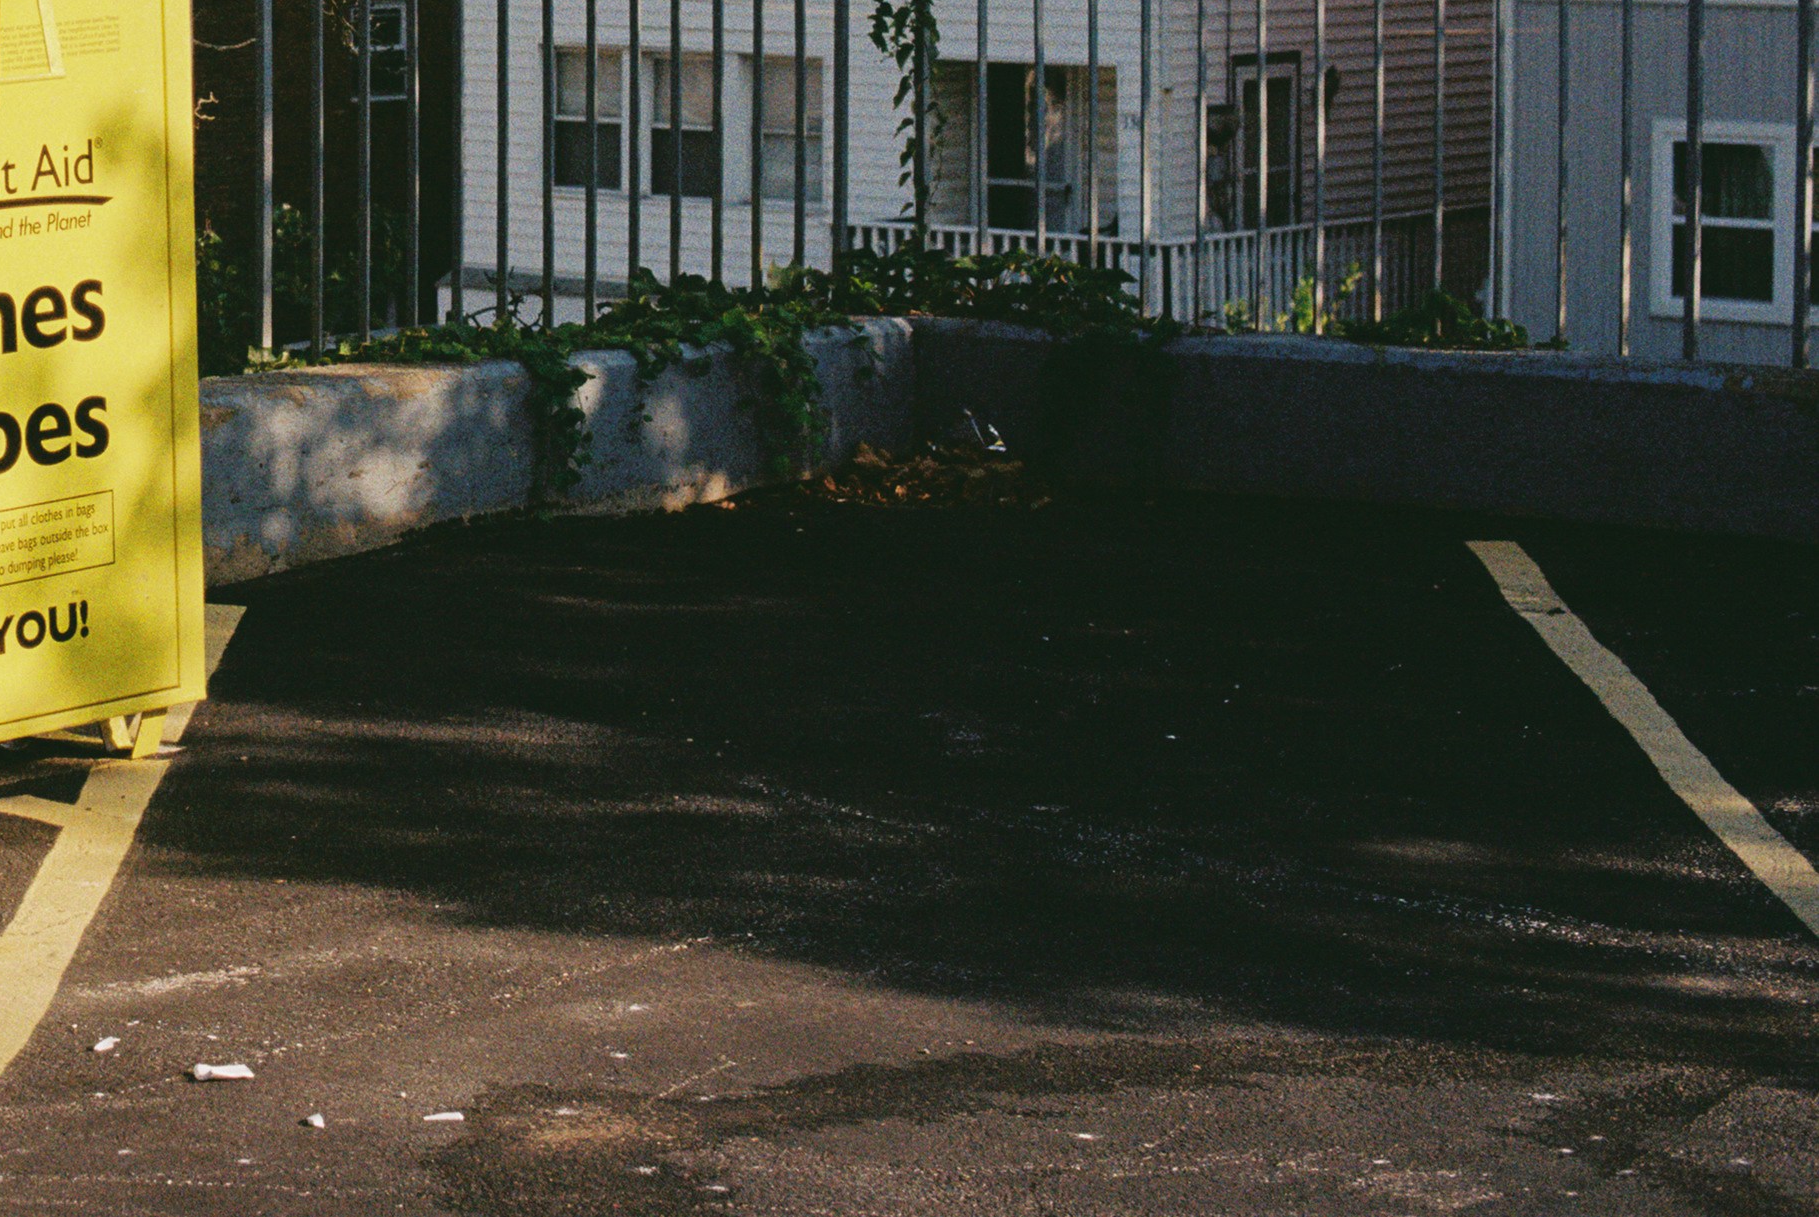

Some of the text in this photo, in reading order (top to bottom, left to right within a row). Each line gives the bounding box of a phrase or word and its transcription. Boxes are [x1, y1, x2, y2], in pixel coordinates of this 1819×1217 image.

[19, 216, 41, 235] the
[47, 210, 92, 232] Planet
[1, 519, 15, 533] put
[19, 514, 28, 527] all
[31, 509, 63, 524] clothes
[66, 507, 73, 518] in
[76, 503, 95, 518] bags
[18, 537, 37, 552] bags
[40, 530, 72, 545] outside
[75, 525, 89, 538] the
[92, 522, 109, 535] box
[8, 557, 45, 574] dumping
[48, 548, 78, 570] please!
